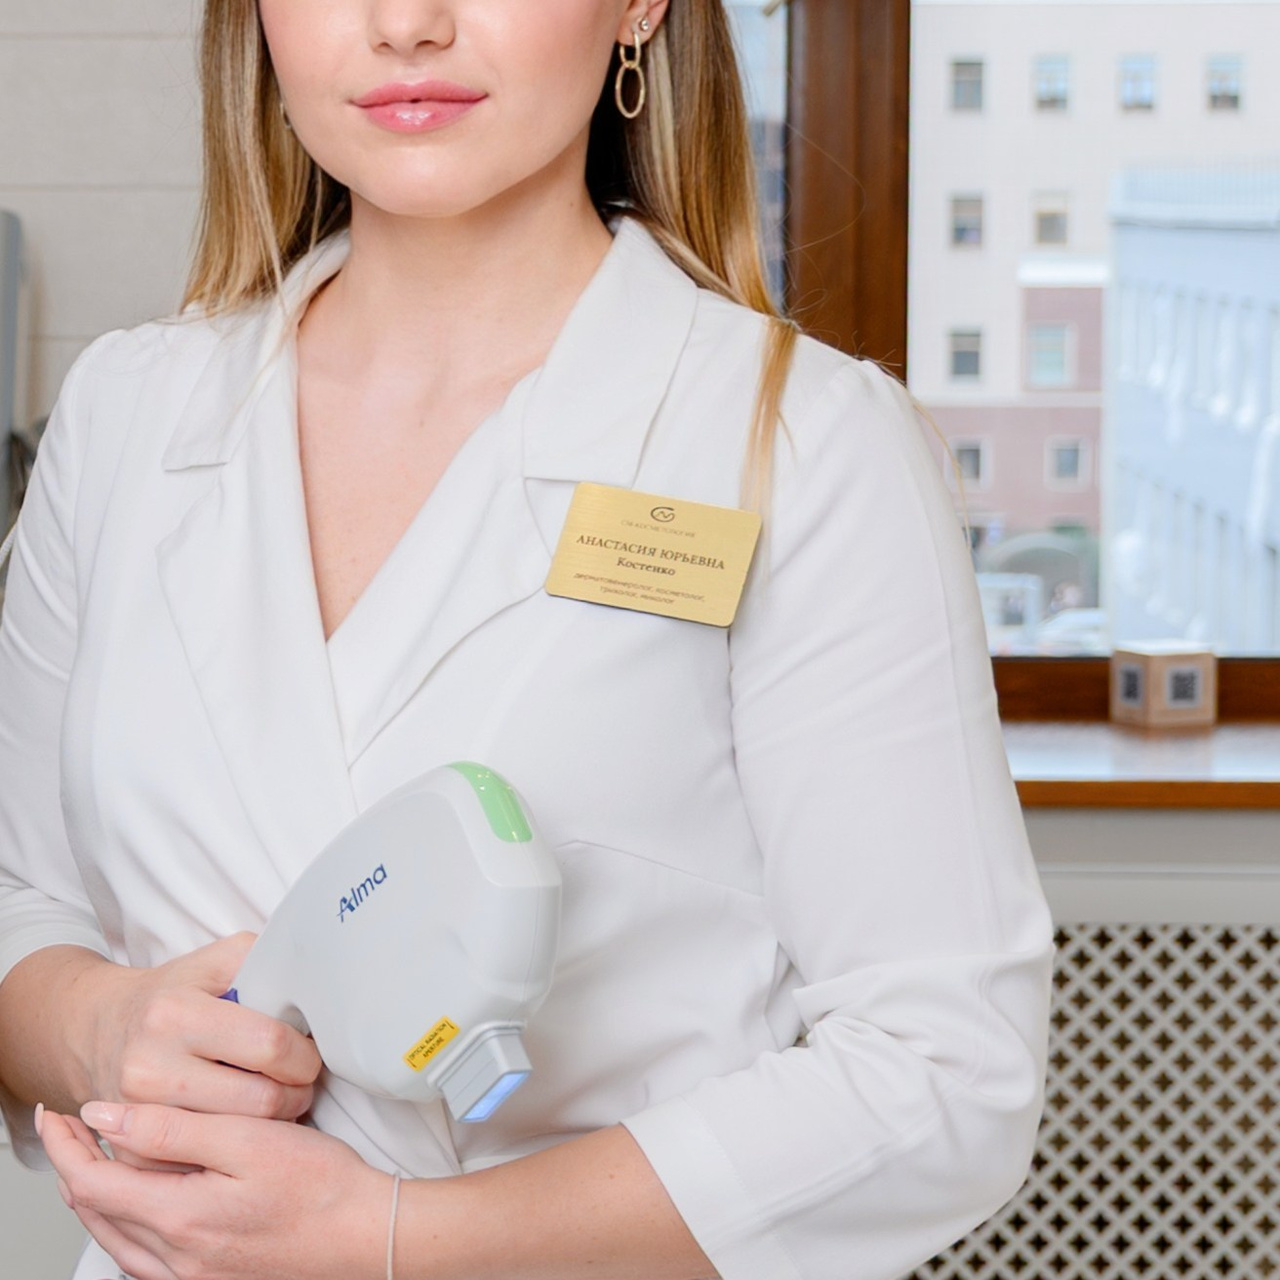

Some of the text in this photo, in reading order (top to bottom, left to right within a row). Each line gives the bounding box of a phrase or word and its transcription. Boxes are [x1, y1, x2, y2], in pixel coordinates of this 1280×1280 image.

[576, 534, 726, 570] АНАСТАСИЯ ЮРЬЕВНА
[616, 556, 677, 577] Костенко
[336, 863, 388, 923] Alma
